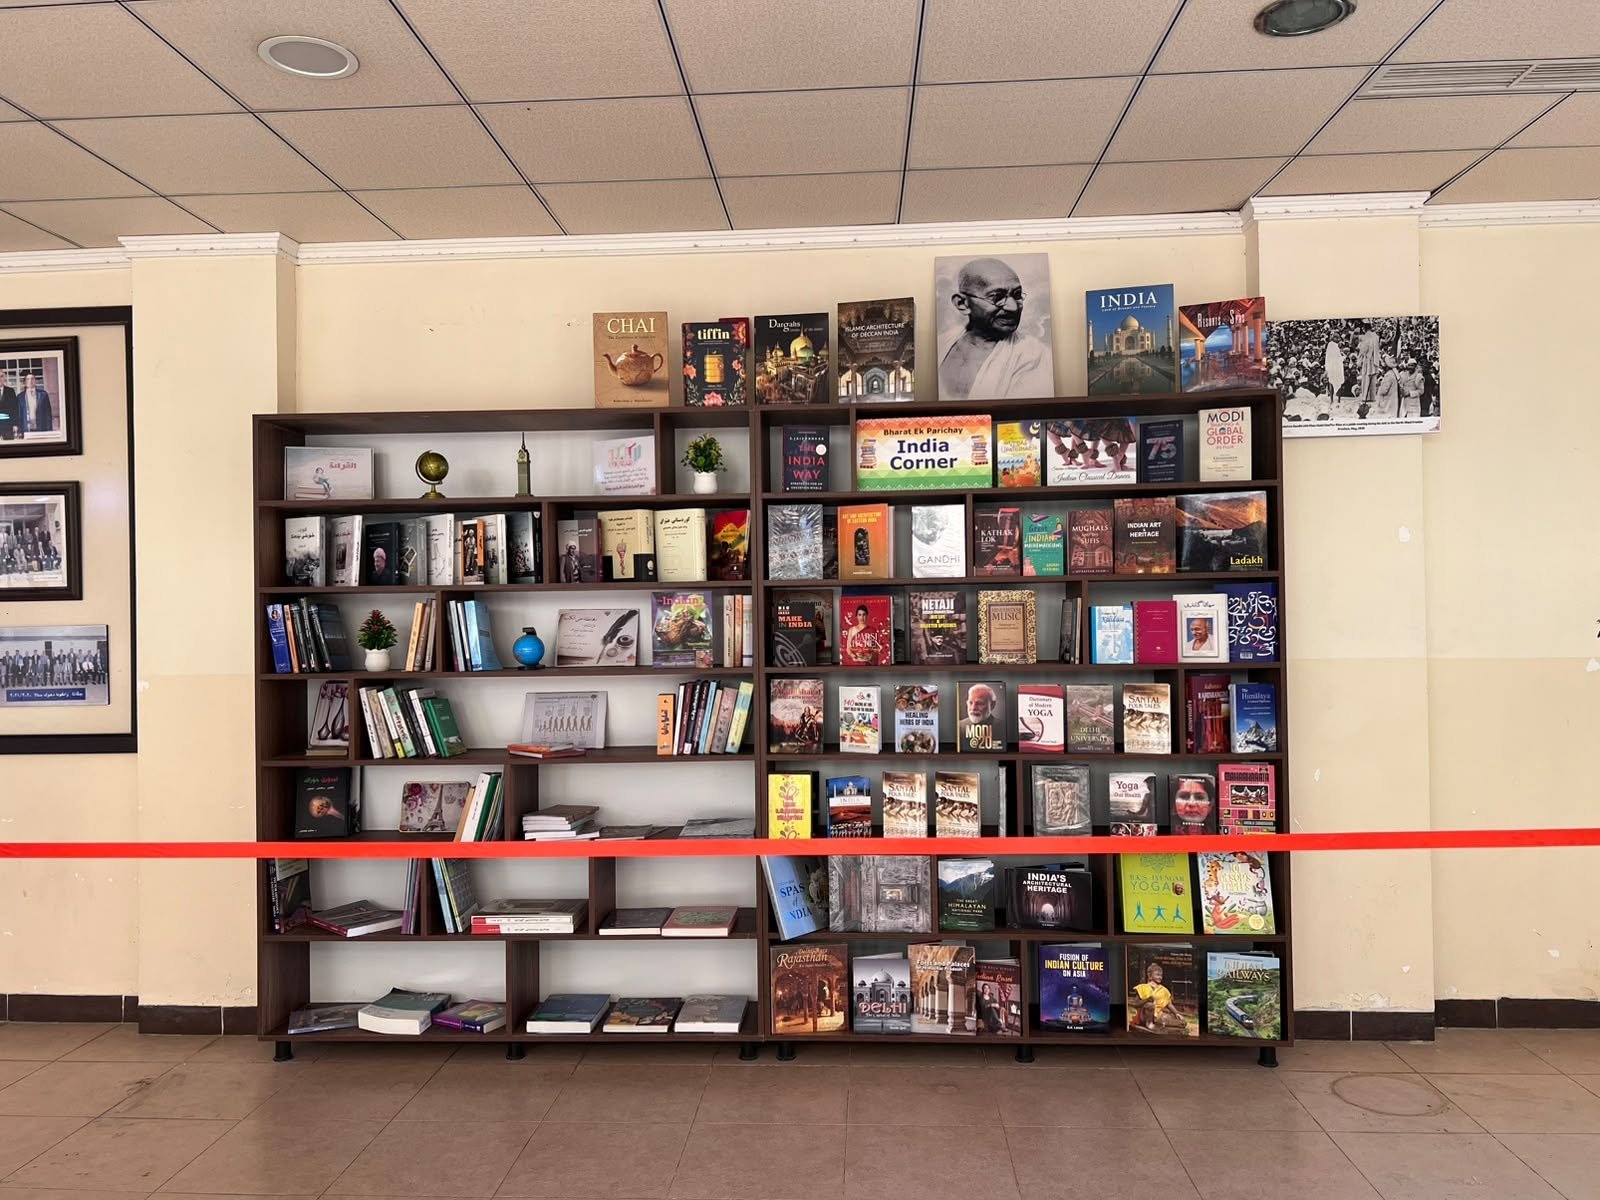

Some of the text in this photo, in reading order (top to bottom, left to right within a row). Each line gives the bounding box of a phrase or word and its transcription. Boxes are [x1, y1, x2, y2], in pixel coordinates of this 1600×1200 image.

[1101, 291, 1158, 308] INDIA
[607, 317, 657, 334] CHAI
[866, 322, 905, 331] ARCHITECTURE
[697, 328, 730, 340] tiffin
[1207, 411, 1244, 423] MODI
[883, 428, 912, 436] Bharat
[926, 427, 964, 436] Parichay
[1207, 435, 1244, 445] ORDER
[897, 439, 950, 454] India
[788, 456, 825, 465] INDIA
[890, 456, 958, 470] Corner
[793, 470, 821, 480] WAY
[981, 529, 1014, 537] KATHAK
[918, 555, 961, 565] GANDHI
[1230, 556, 1263, 566] Ladakh
[922, 598, 955, 611] NETAJI
[992, 612, 1022, 621] MUSIC
[1128, 695, 1161, 704] SANTAL
[1028, 709, 1053, 717] YOGA
[965, 724, 993, 738] MODI
[969, 736, 992, 750] @20
[1116, 781, 1139, 791] Yoga
[1027, 872, 1067, 882] INDIA'S
[1022, 880, 1072, 888] ARCHITECTURAL
[1130, 881, 1170, 892] YOGA
[780, 883, 805, 898] SPAS
[1027, 885, 1068, 894] HERITAGE
[784, 906, 813, 921] NDIA
[777, 953, 828, 969] Rajasthan
[1059, 953, 1080, 961] FUSION
[1045, 960, 1104, 971] INDIAN CULTURE
[1073, 970, 1086, 978] ASIA
[1216, 968, 1271, 982] RAILWAYS
[859, 1002, 907, 1014] DELHI
